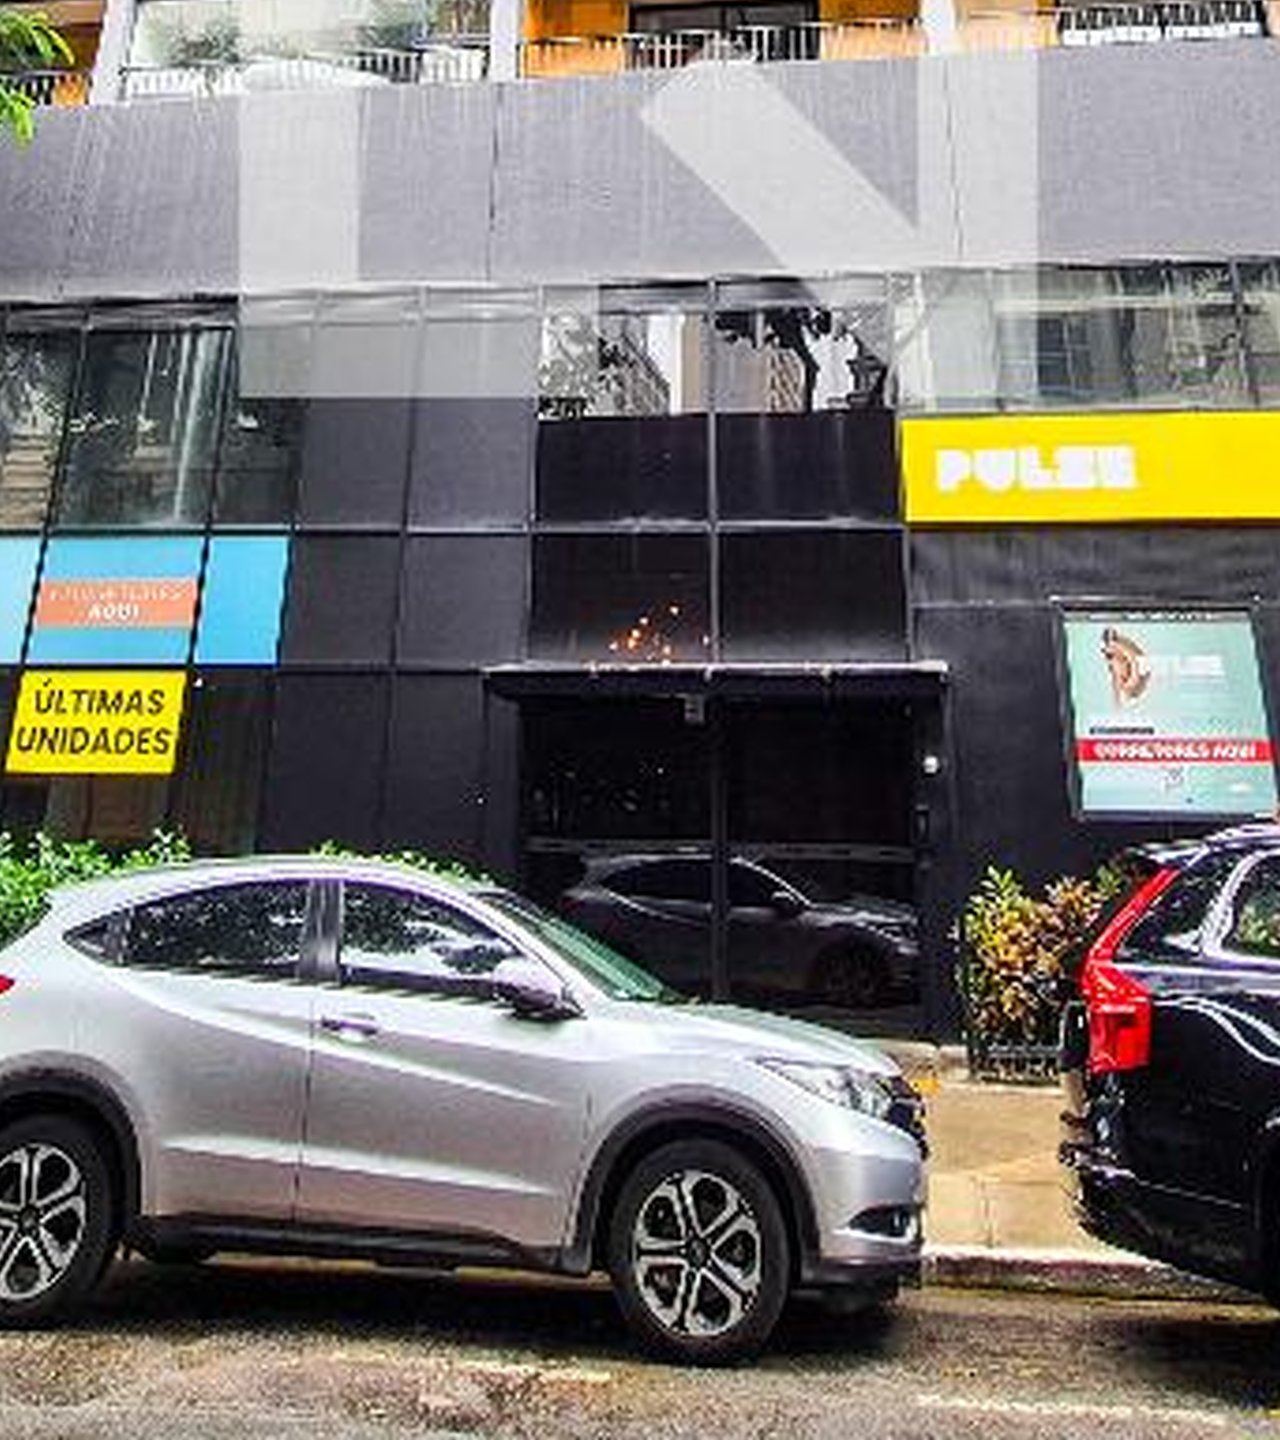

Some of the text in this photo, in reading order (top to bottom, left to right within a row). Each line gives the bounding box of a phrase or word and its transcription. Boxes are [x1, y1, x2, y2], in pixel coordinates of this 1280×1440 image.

[935, 444, 1138, 492] PULSE
[88, 602, 140, 620] AQUI
[34, 677, 165, 715] ÚLTIMAS
[16, 726, 173, 755] UNIDADES
